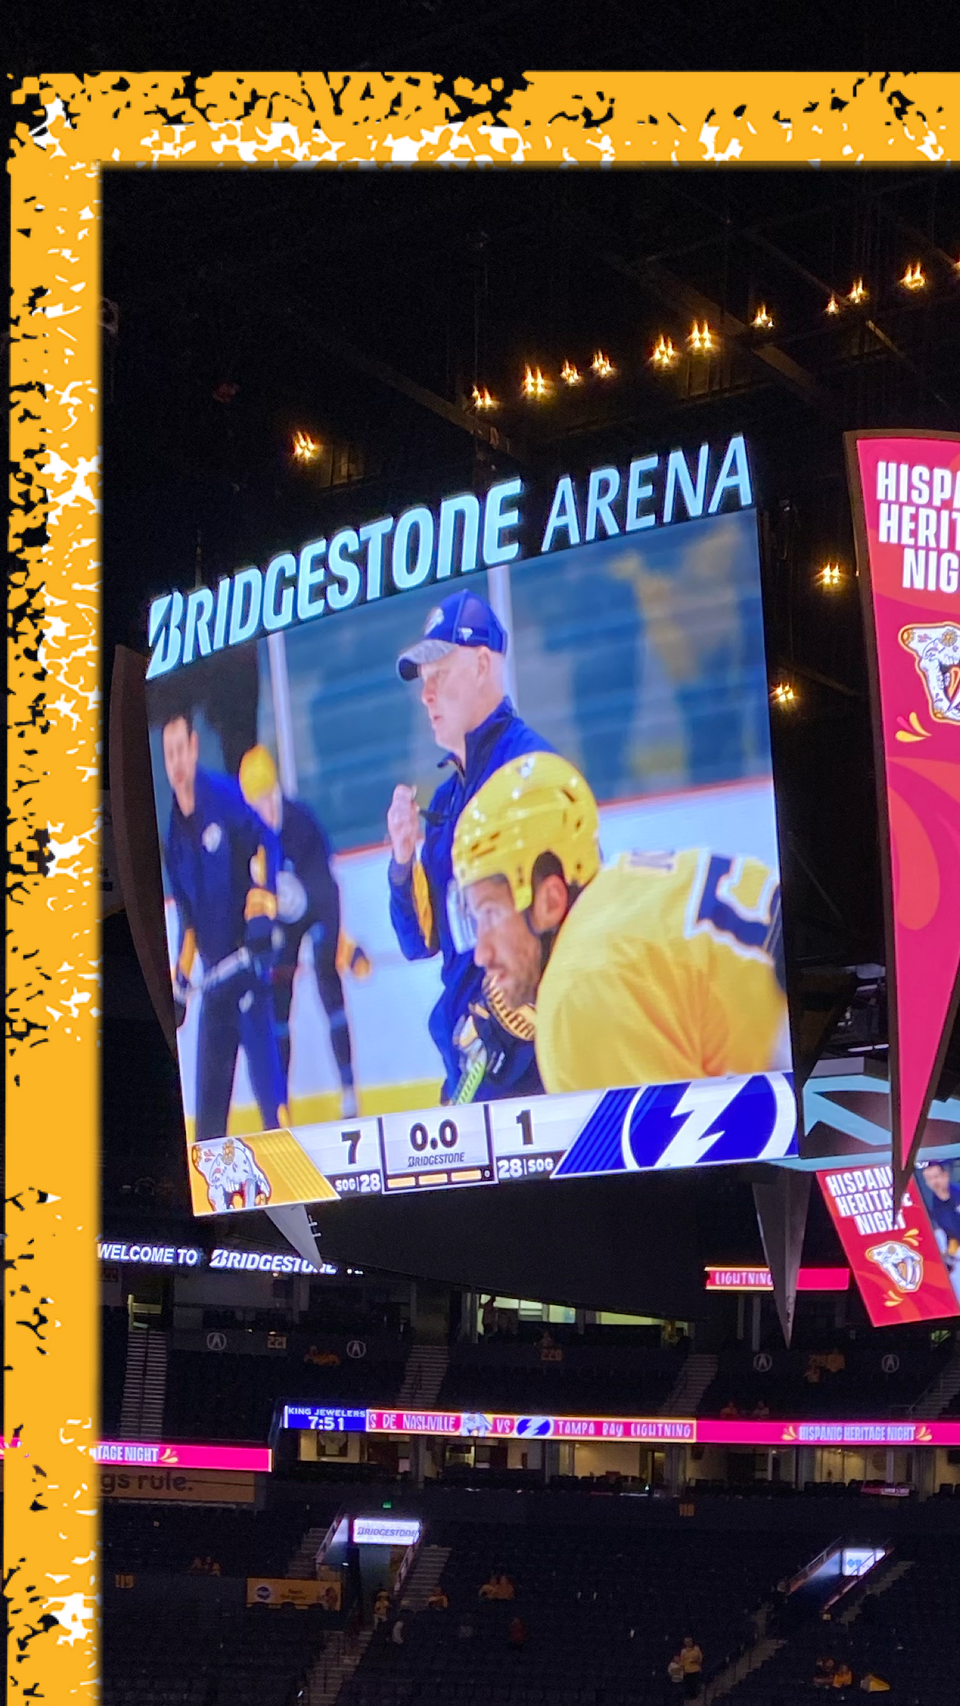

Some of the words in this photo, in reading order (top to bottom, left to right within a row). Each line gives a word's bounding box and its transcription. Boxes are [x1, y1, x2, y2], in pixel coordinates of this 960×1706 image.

[145, 477, 522, 680] BRIDGESTONE
[541, 433, 752, 553] ARENA
[410, 1119, 458, 1151] 0.0
[515, 1109, 534, 1146] 1
[341, 1129, 361, 1165] 7
[408, 1152, 465, 1168] BRIDGESTONE
[498, 1159, 522, 1178] 28
[360, 1173, 381, 1193] 28
[835, 1187, 913, 1217] HERITAE
[98, 1243, 175, 1264] WELCOME
[177, 1248, 198, 1266] TO
[288, 1407, 311, 1415] KING
[314, 1409, 366, 1418] JEWELERS
[308, 1416, 345, 1431] 7:51
[403, 1414, 455, 1431] NASHVILLE
[496, 1419, 510, 1433] VS
[558, 1421, 595, 1435] TAMPA
[631, 1422, 692, 1438] LIGHTNING
[124, 1446, 159, 1462] NIGHT
